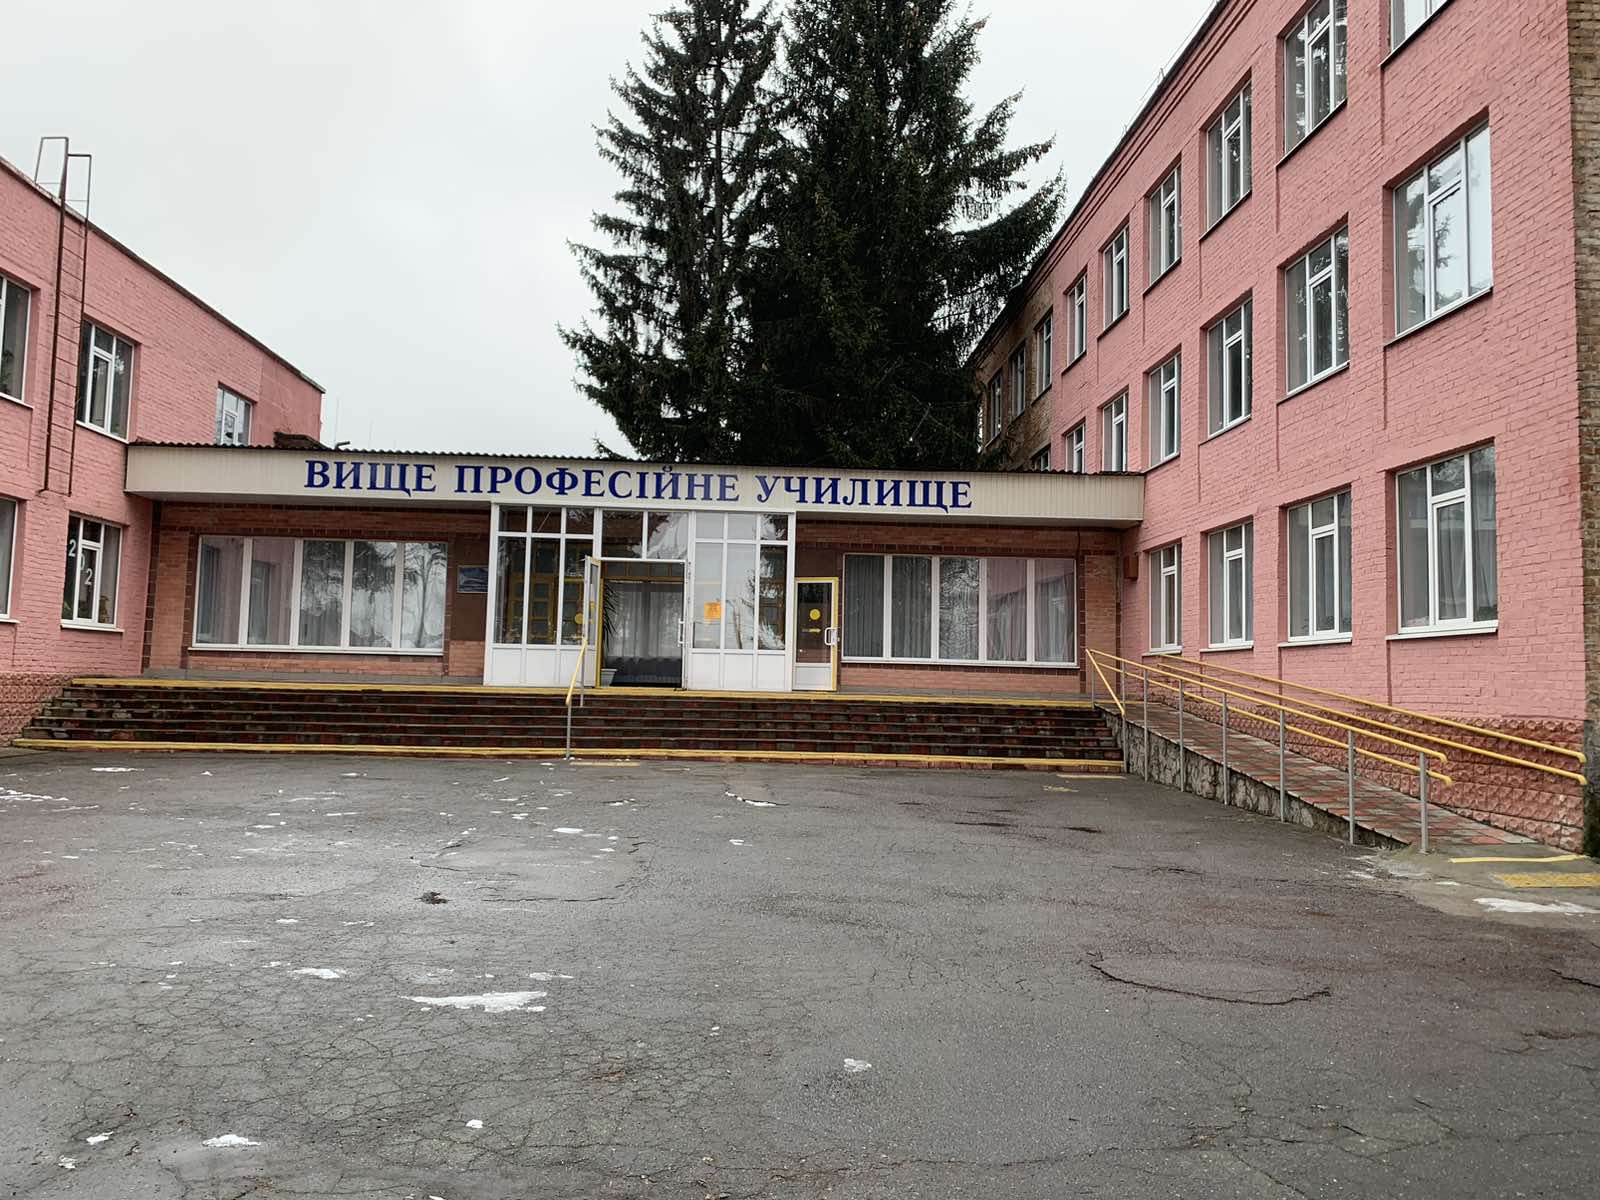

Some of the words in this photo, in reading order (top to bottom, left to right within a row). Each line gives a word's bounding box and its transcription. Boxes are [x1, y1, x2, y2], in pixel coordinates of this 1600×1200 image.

[304, 459, 437, 497] ВИЩЕ
[453, 464, 741, 503] ПРОФЕСІЙНЕ
[755, 474, 974, 514] УЧИЛИЩЕ
